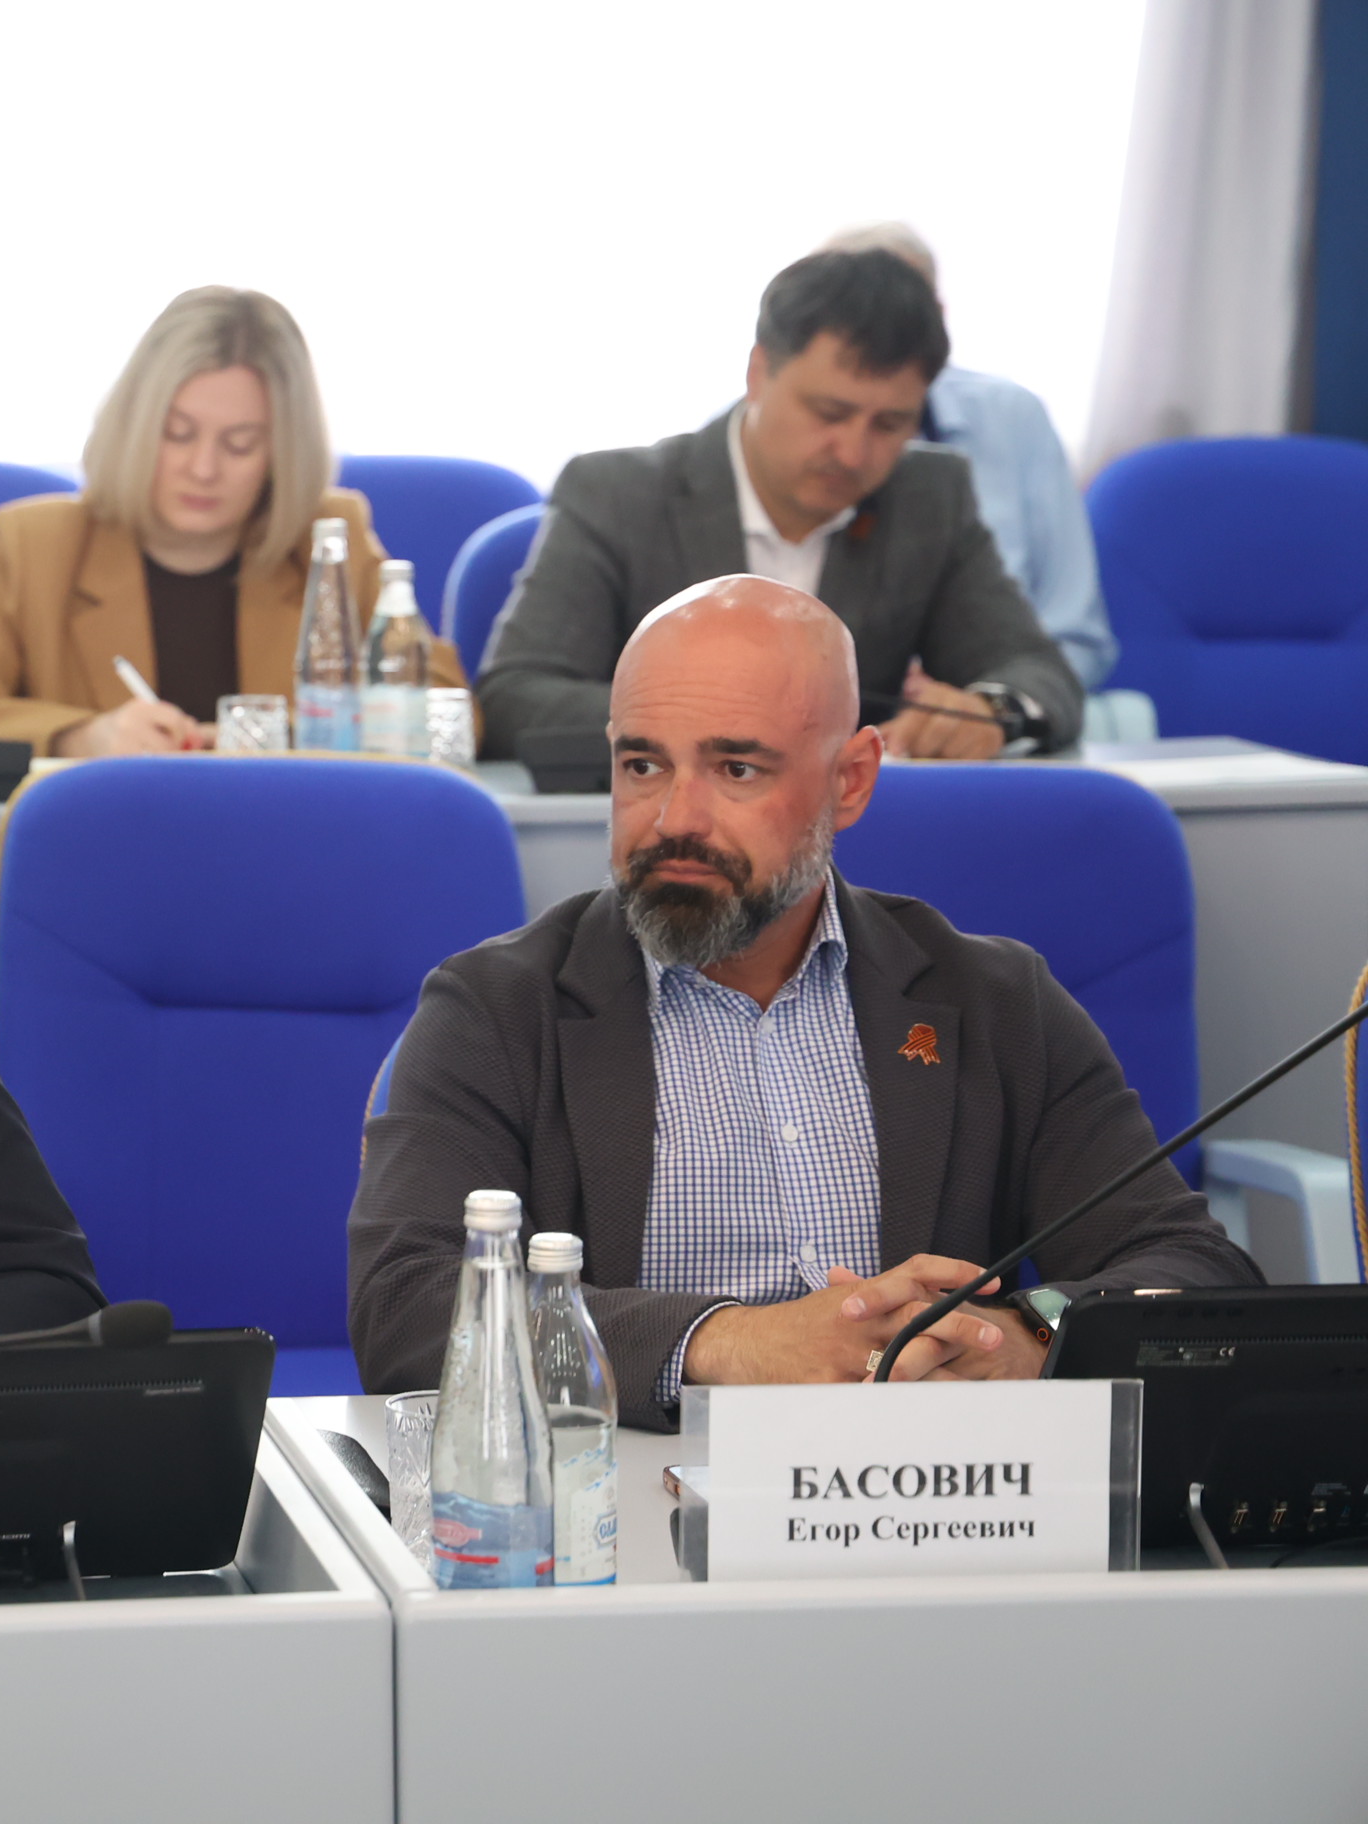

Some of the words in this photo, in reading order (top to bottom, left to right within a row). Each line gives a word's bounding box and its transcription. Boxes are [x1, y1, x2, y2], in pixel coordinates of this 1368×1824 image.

[790, 1462, 1033, 1500] БАСОВИЧ
[787, 1516, 861, 1548] Егор
[871, 1515, 1035, 1546] Сергеевич
